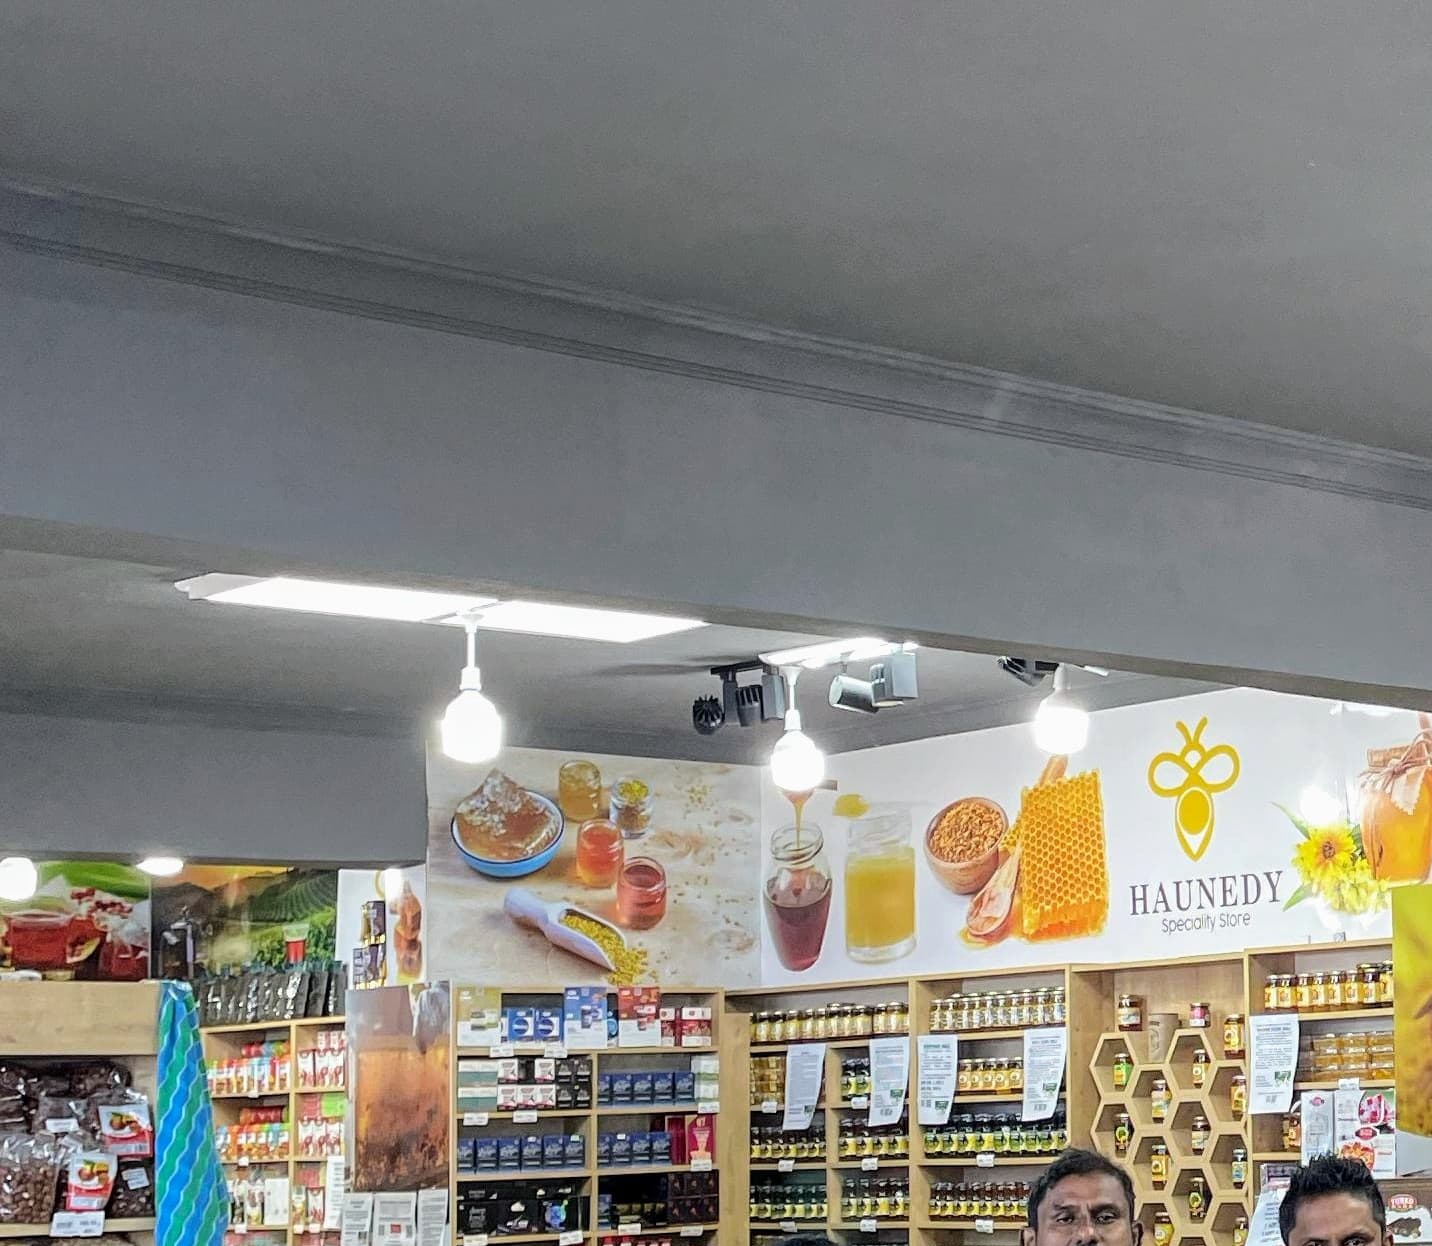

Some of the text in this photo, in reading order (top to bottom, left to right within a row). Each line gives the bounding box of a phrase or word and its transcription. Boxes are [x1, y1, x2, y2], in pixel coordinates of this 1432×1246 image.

[1129, 870, 1284, 916] HAUNEDY
[1161, 911, 1252, 936] Speciality Store
